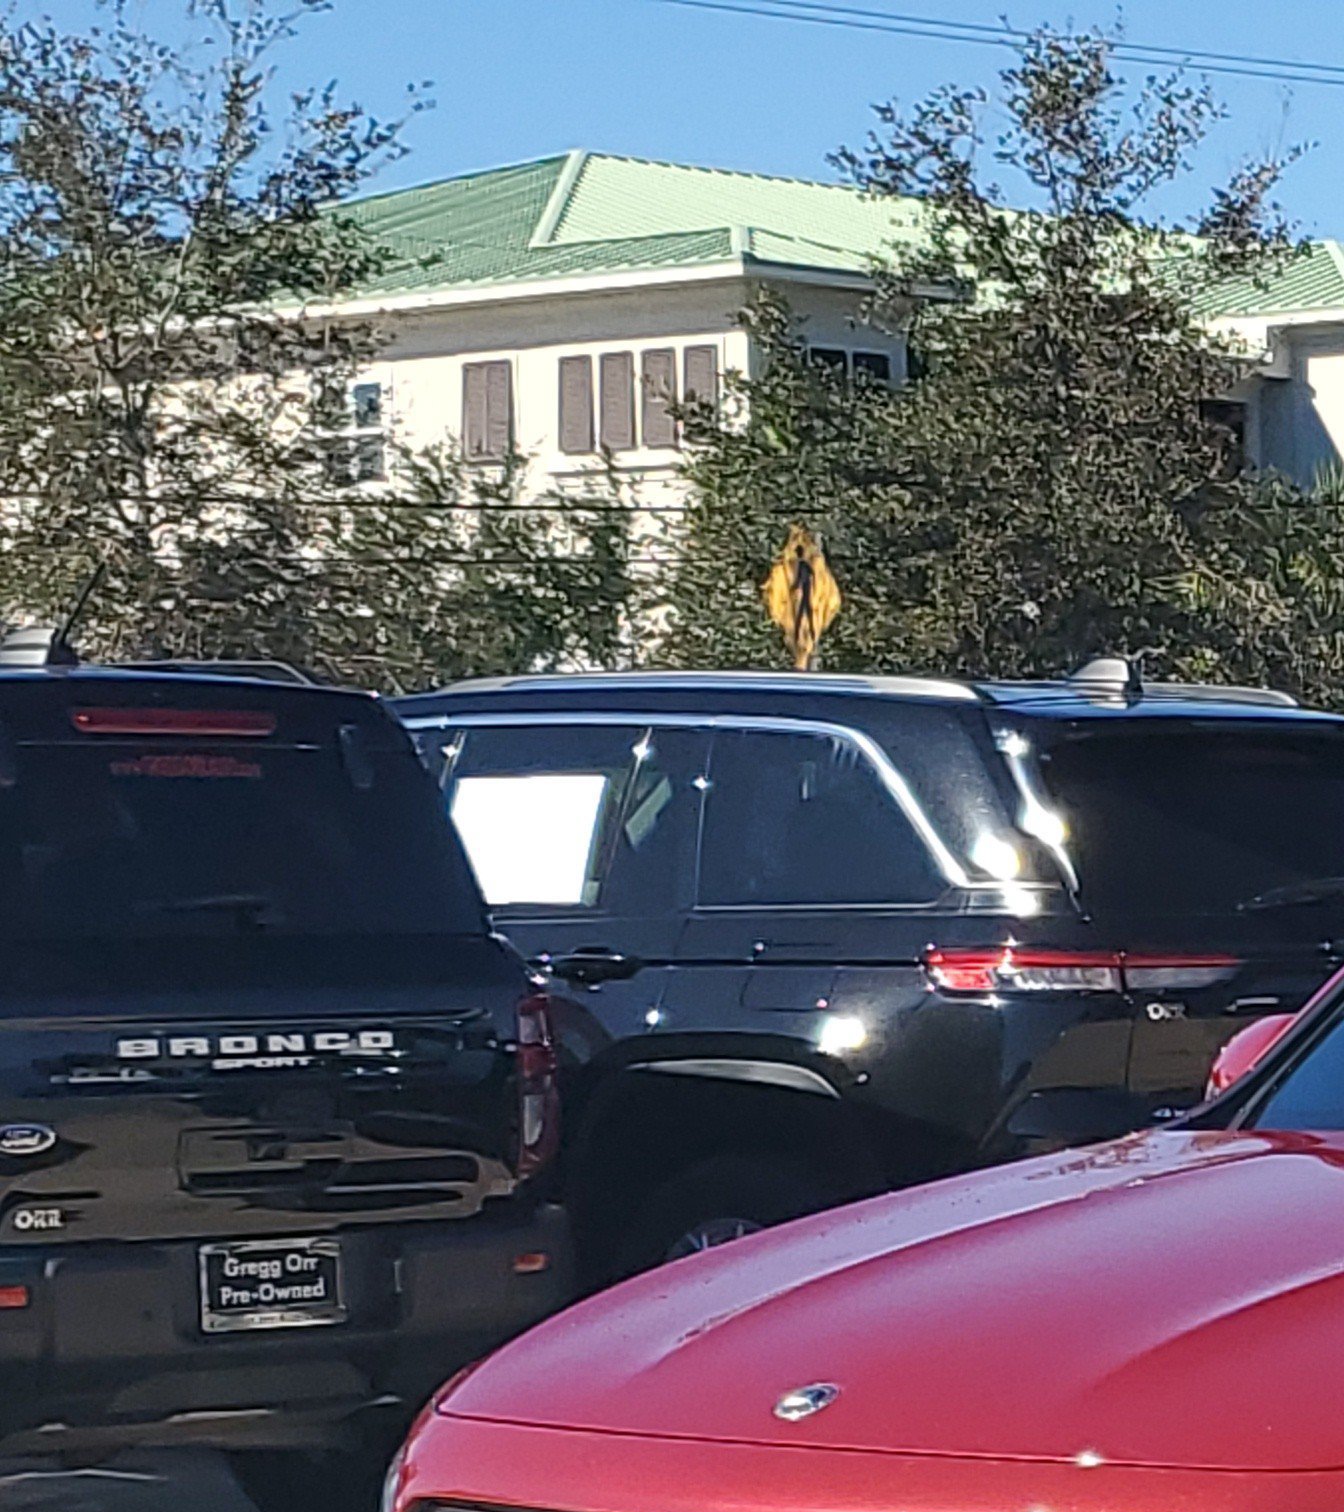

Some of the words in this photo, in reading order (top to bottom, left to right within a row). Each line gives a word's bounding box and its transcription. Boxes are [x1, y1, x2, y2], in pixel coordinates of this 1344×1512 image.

[117, 1031, 394, 1058] BRONCO
[211, 1056, 314, 1070] SPORT
[14, 1208, 63, 1230] ORR
[223, 1257, 283, 1279] Gregg
[285, 1253, 319, 1273] Orr
[220, 1276, 326, 1306] Pre-Owned
